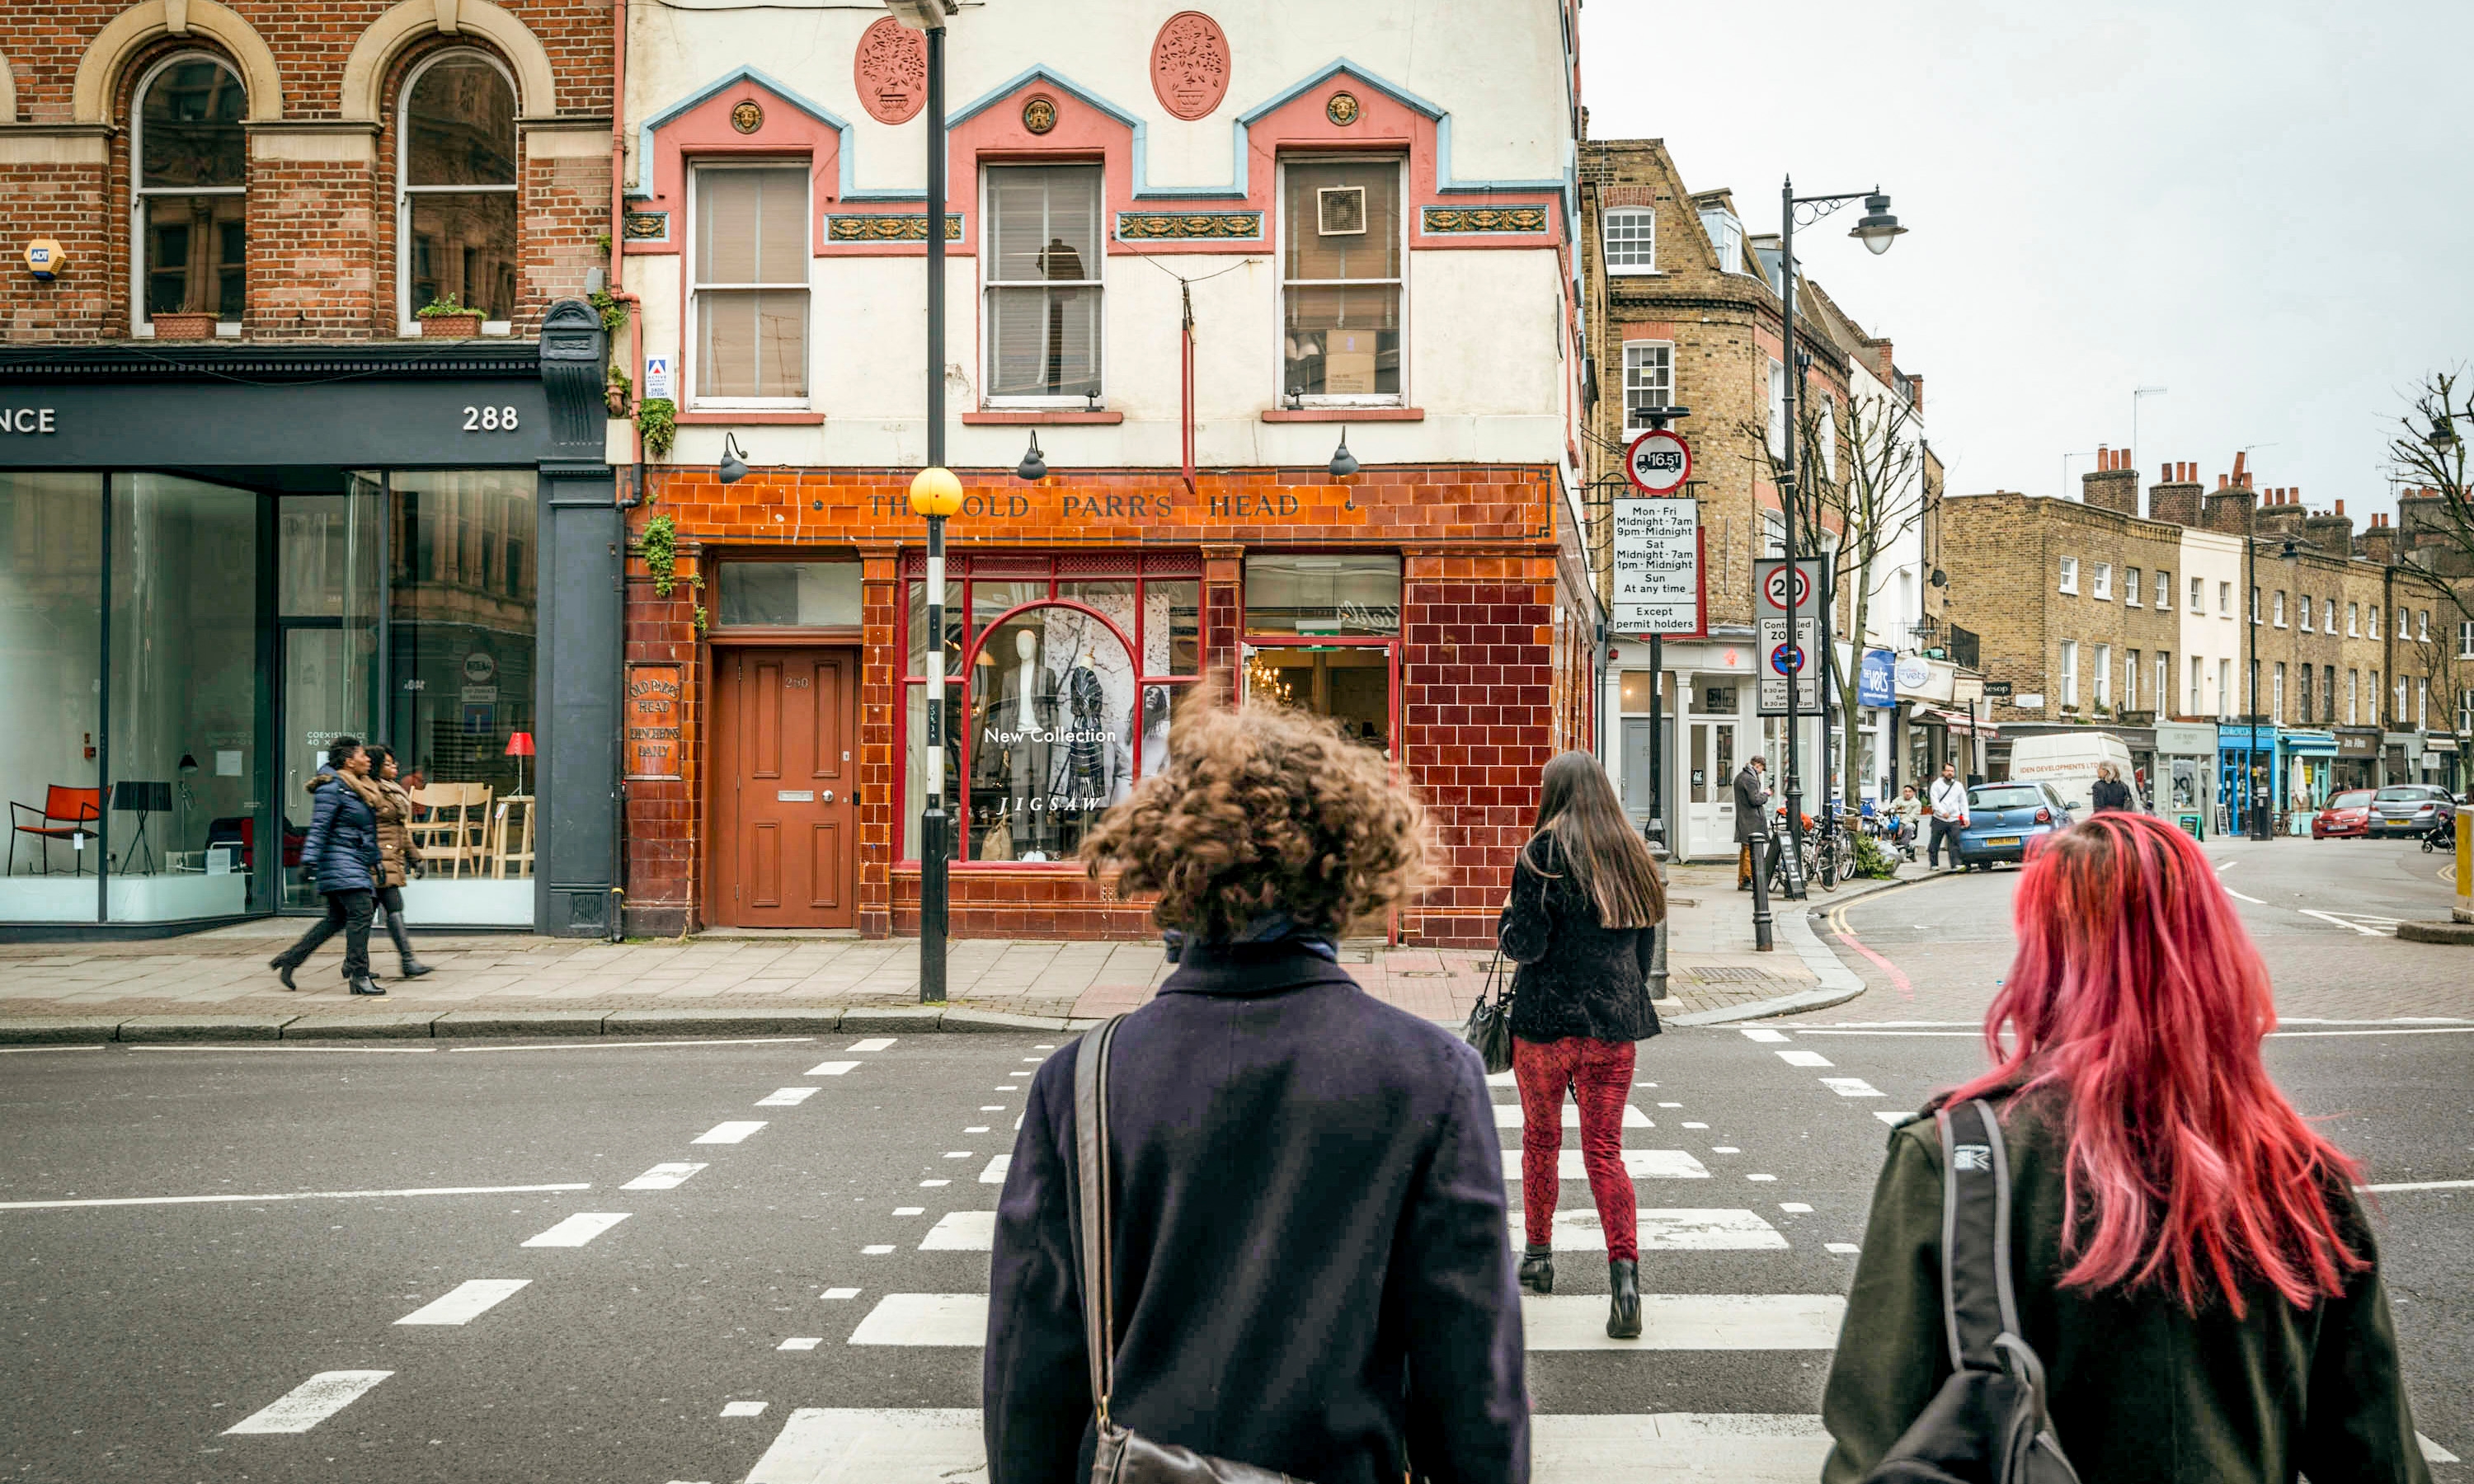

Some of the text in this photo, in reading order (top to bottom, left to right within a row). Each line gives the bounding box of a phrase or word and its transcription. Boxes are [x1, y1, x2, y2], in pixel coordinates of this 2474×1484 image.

[32, 251, 49, 260] ADT
[0, 409, 55, 432] NCE
[463, 406, 519, 430] 288
[1650, 453, 1681, 467] 16.5T
[867, 494, 1299, 518] TH OLD PARR'S HEAD
[1633, 507, 1655, 515] Mon
[1663, 507, 1677, 515] Fri
[1617, 517, 1663, 527] Midnight
[1671, 517, 1692, 525] 7am
[1617, 528, 1639, 537] 9pm
[1646, 528, 1692, 537] Midnight
[1646, 540, 1664, 548] Sat
[1617, 550, 1663, 560] Midnight
[1672, 550, 1692, 558] 7am
[1617, 561, 1638, 570] 1pm
[1646, 561, 1692, 570] Midnight
[1645, 574, 1665, 582] Sun
[1624, 585, 1686, 594] At any time
[1637, 607, 1673, 617] Except
[1616, 620, 1693, 629] permit holders
[1764, 621, 1811, 629] Contled
[1771, 631, 1804, 640] ZOE
[1870, 666, 1888, 693] vets
[1906, 670, 1926, 679] vets
[630, 679, 649, 697] OLD
[638, 700, 670, 712] HEAD
[985, 726, 1116, 743] New Collection
[638, 744, 670, 757] DAILY
[2036, 763, 2086, 773] DEVELOPMENTS
[996, 797, 1100, 815] JIGSAW
